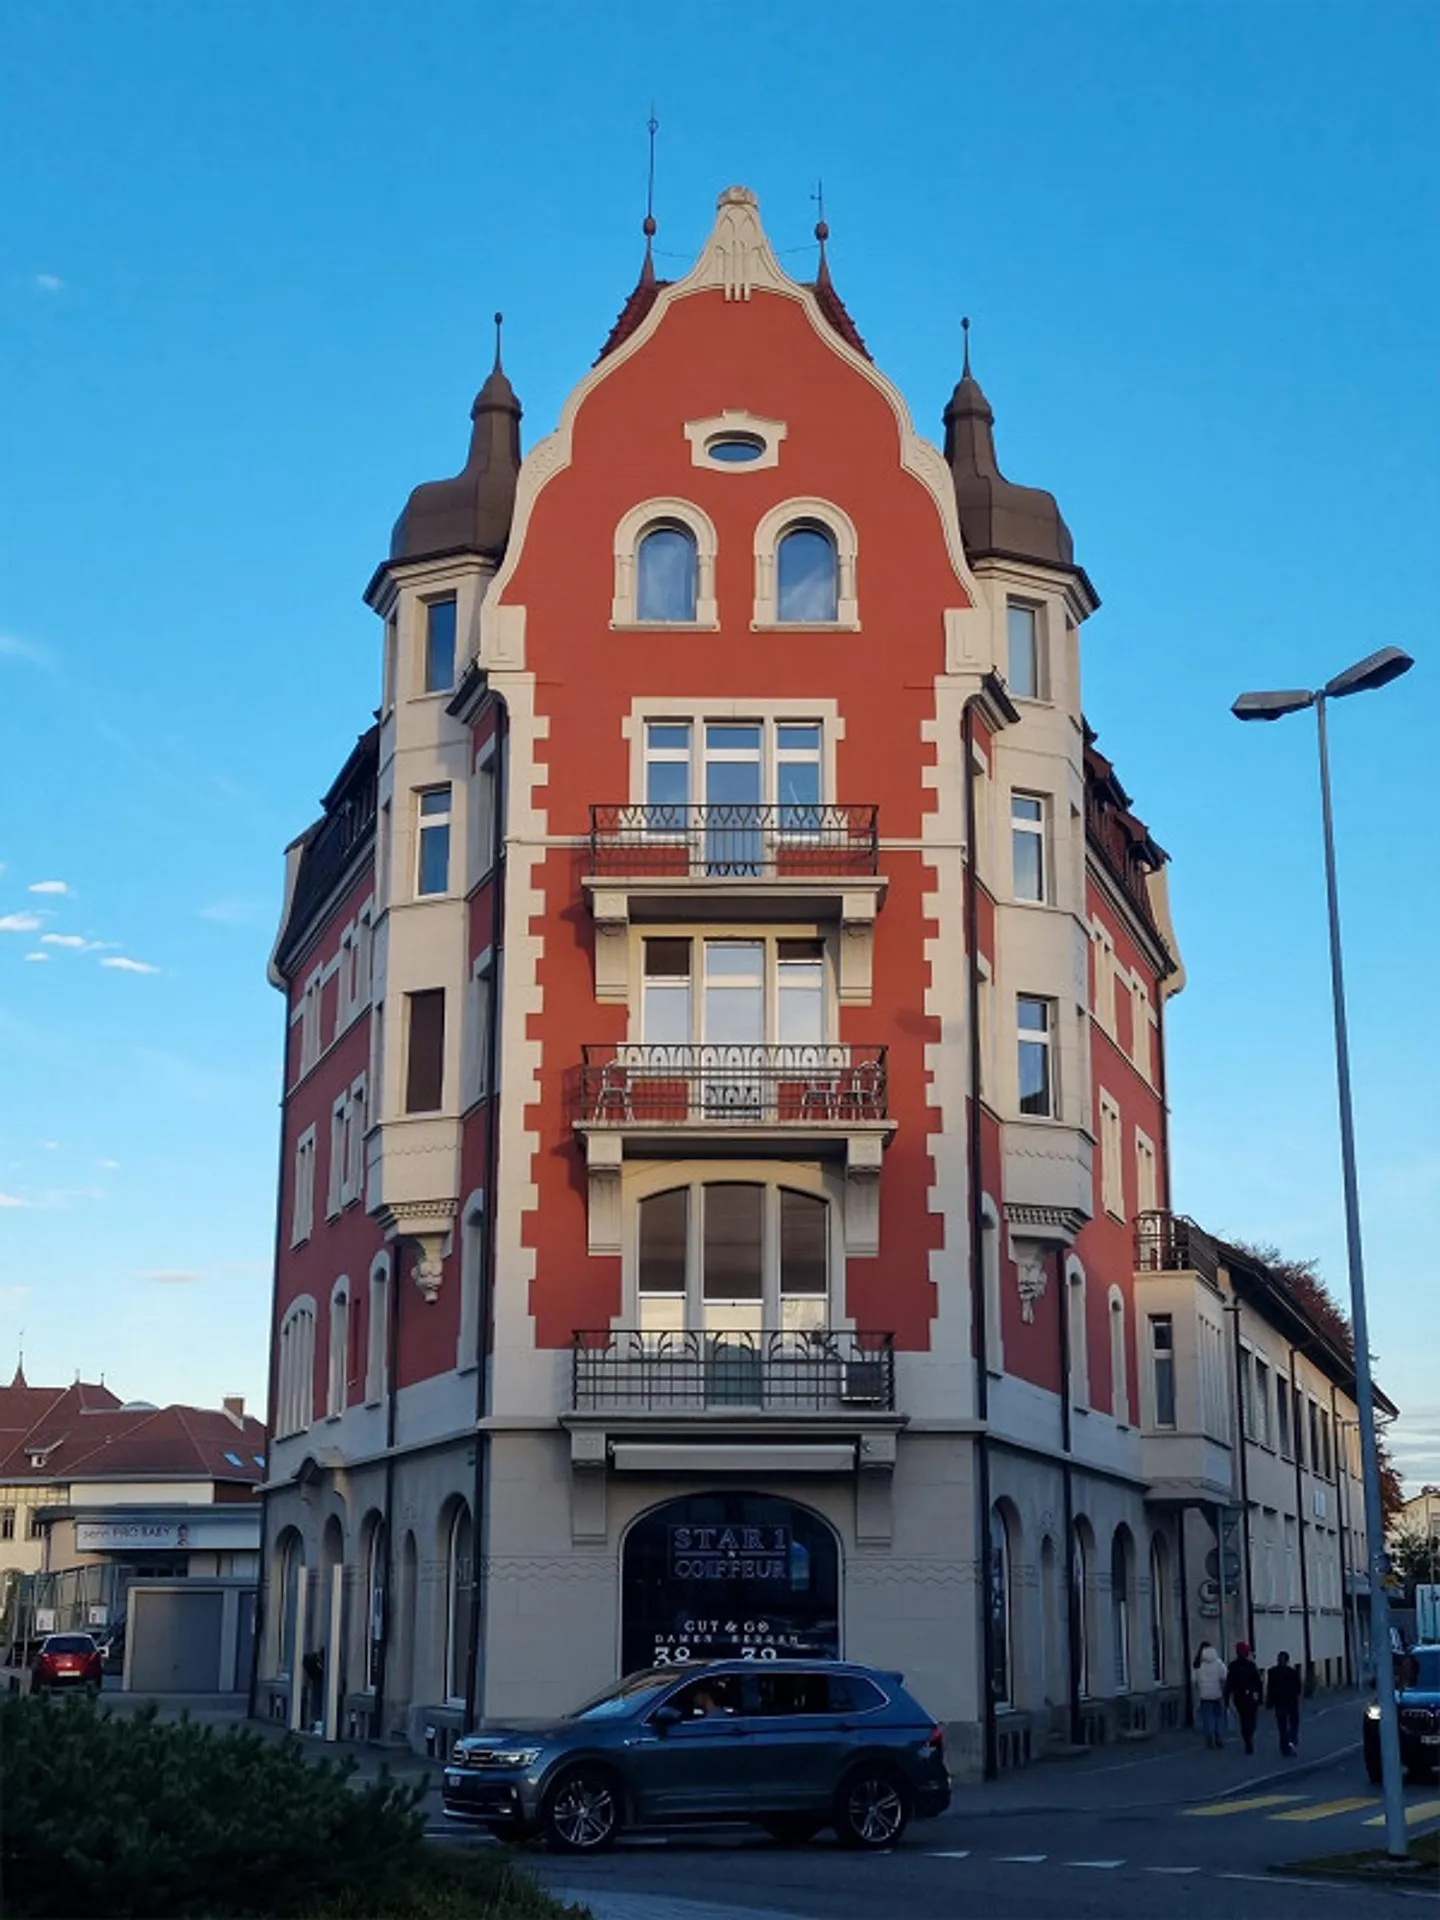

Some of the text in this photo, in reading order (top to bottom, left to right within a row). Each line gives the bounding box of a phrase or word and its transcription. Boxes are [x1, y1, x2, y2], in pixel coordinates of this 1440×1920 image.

[674, 1528, 764, 1549] STAR
[674, 1559, 786, 1578] COIFFEUR
[684, 1620, 770, 1633] CUT & GO
[655, 1634, 712, 1643] DAMEN
